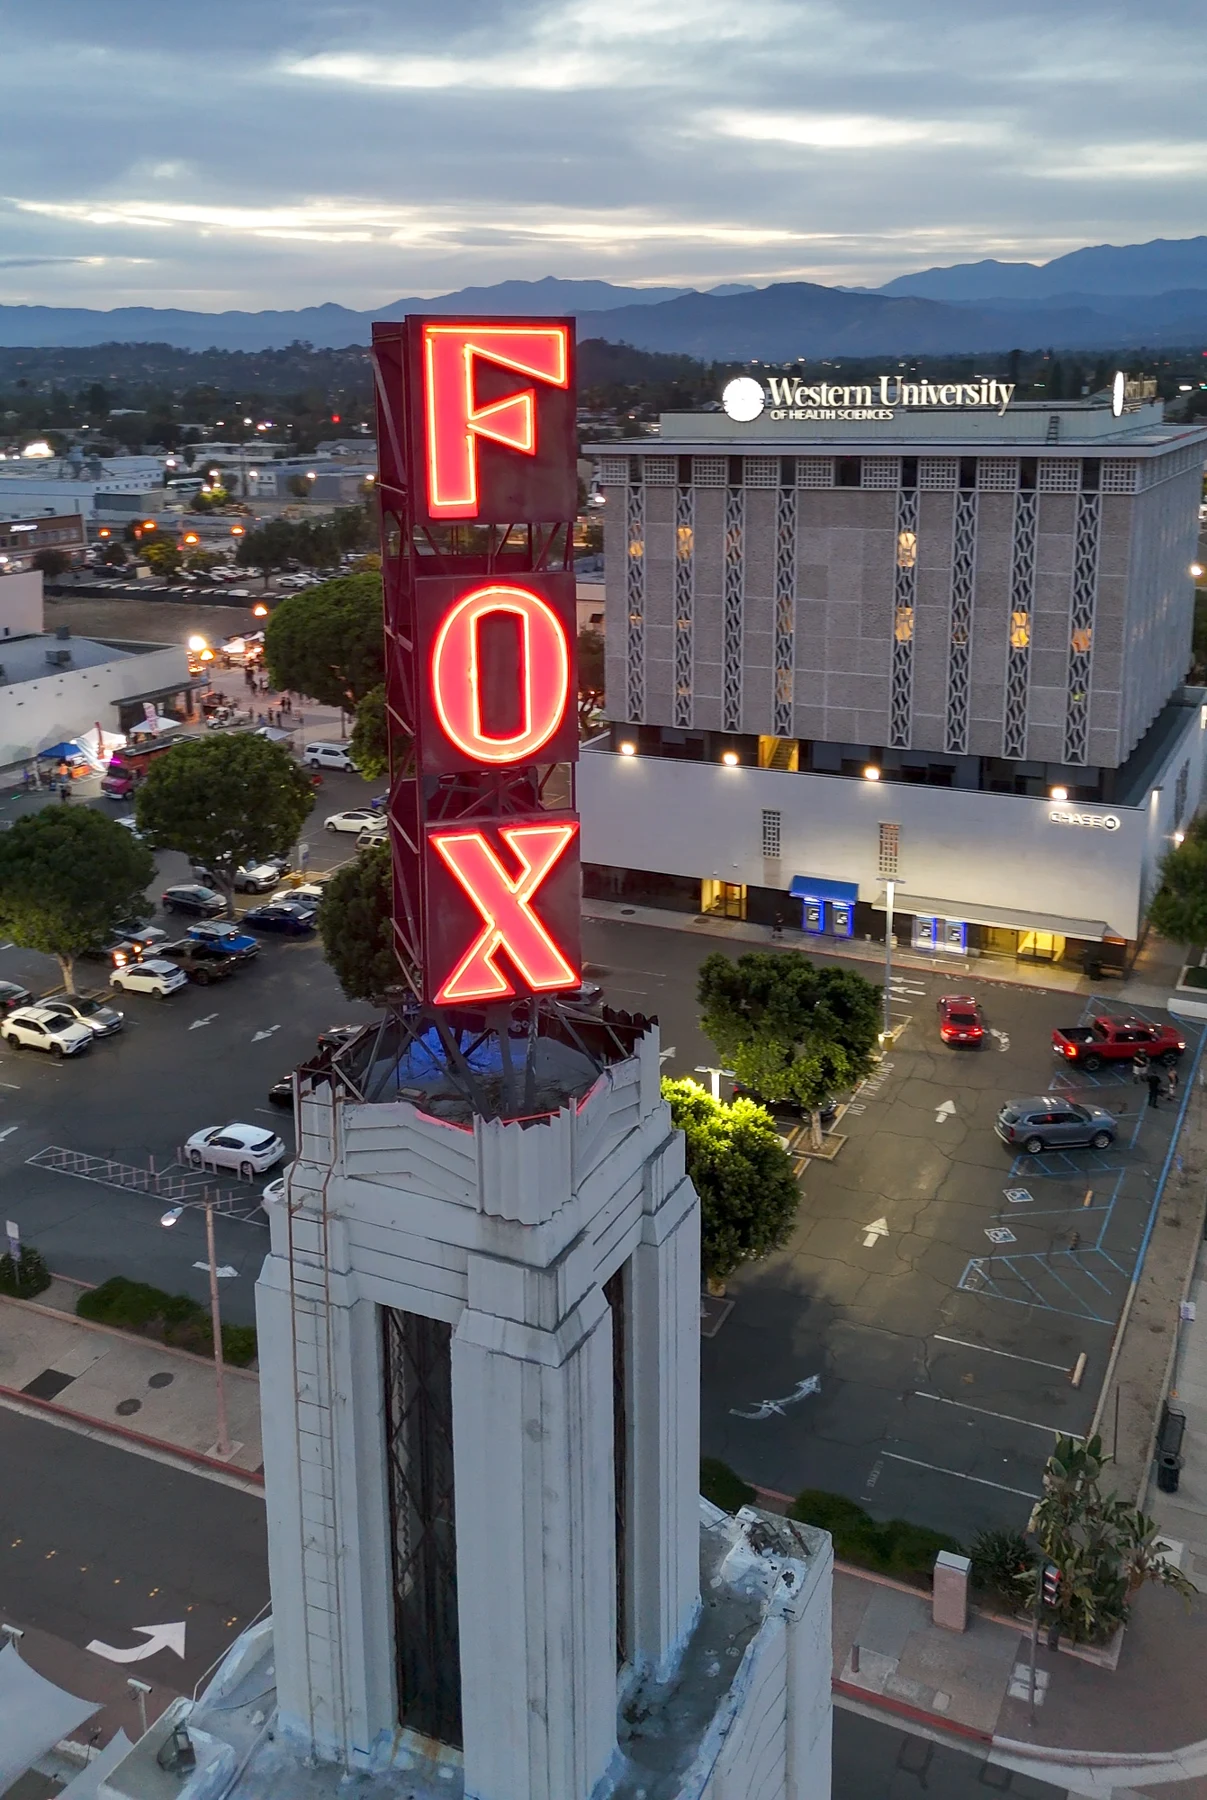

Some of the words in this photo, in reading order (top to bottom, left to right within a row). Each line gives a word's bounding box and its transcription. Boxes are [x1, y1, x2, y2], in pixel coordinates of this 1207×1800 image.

[766, 377, 873, 407] Western
[878, 375, 1016, 417] University
[770, 409, 788, 420] OF
[789, 409, 836, 420] HEALTH
[837, 408, 895, 420] SCIENCES
[422, 324, 582, 1005] FOX
[1049, 811, 1103, 828] CHASE
